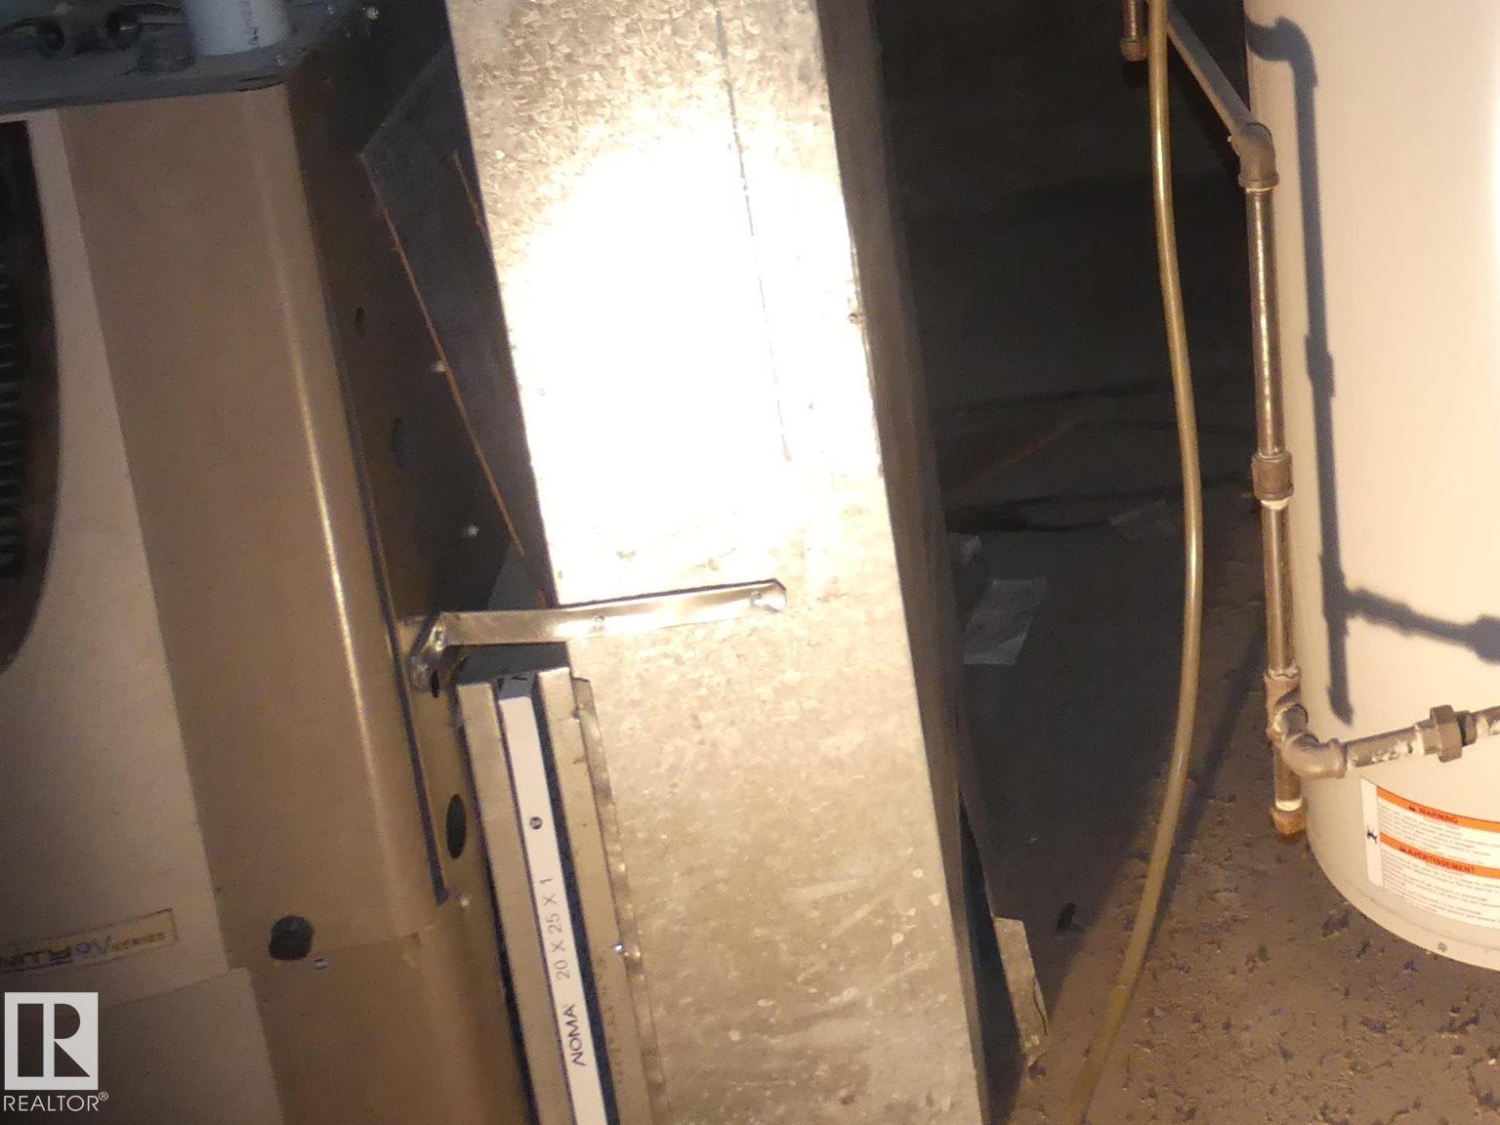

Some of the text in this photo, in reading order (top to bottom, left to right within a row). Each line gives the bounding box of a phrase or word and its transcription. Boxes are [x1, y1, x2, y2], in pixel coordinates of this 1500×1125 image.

[1419, 806, 1459, 824] WARNING
[542, 893, 556, 905] X
[545, 913, 562, 935] 25
[552, 940, 566, 952] X
[554, 959, 571, 981] 20
[562, 1004, 588, 1067] NOMA
